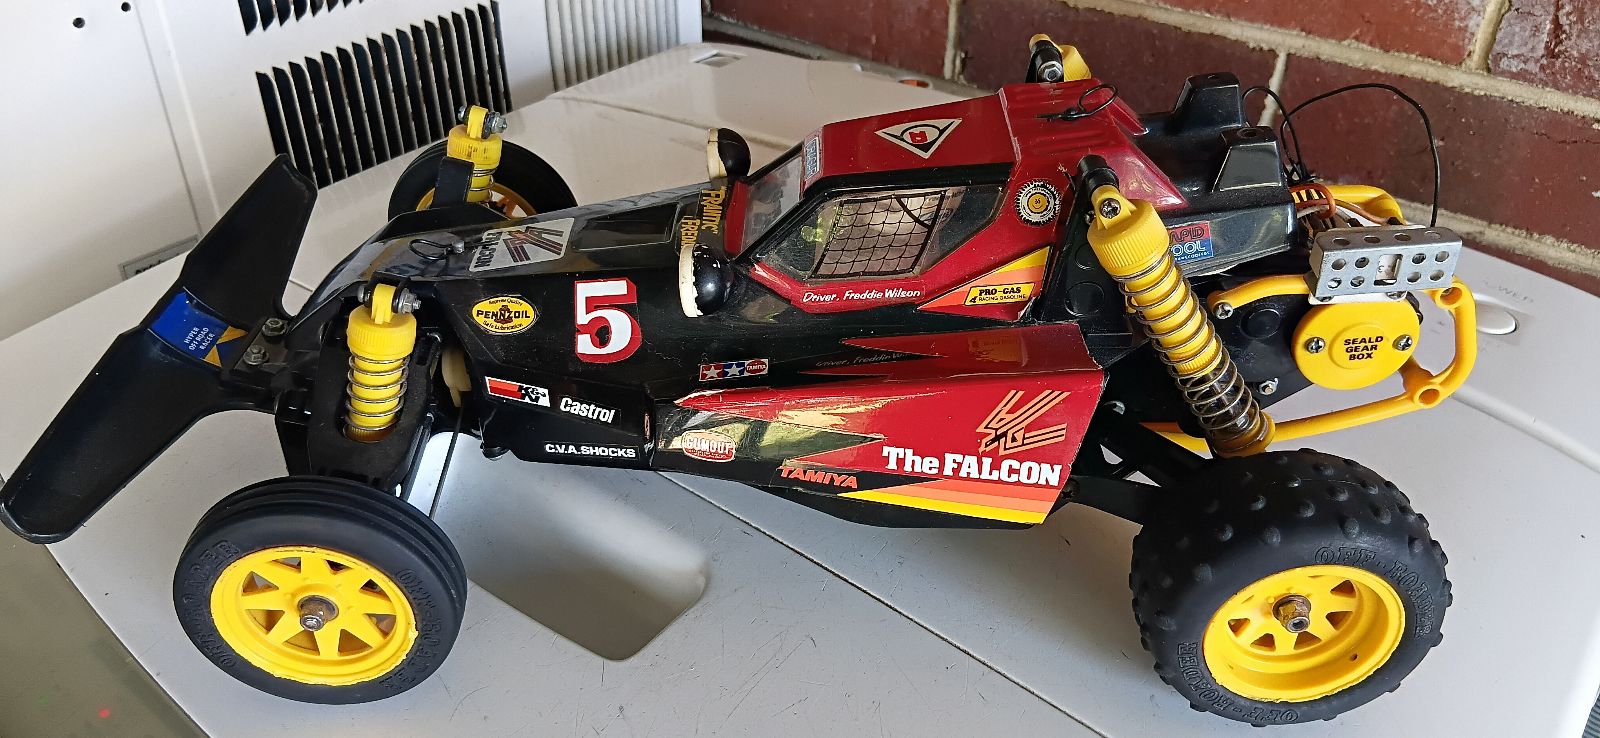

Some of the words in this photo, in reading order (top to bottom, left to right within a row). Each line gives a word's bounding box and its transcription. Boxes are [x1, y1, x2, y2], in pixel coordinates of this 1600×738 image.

[1169, 226, 1204, 243] APID
[1171, 240, 1205, 257] OOL
[843, 290, 883, 301] Freddie
[884, 287, 921, 299] Wilson
[978, 287, 1022, 297] PRO-GAS
[476, 310, 531, 320] PENNZOIL
[575, 278, 642, 363] 5
[1344, 335, 1384, 346] SEALD
[1345, 344, 1378, 353] GEAR
[1348, 352, 1374, 361] BOX
[559, 397, 617, 424] Castrol
[882, 445, 940, 475] The
[943, 452, 1062, 486] FALCON
[777, 465, 858, 489] TAMIYA
